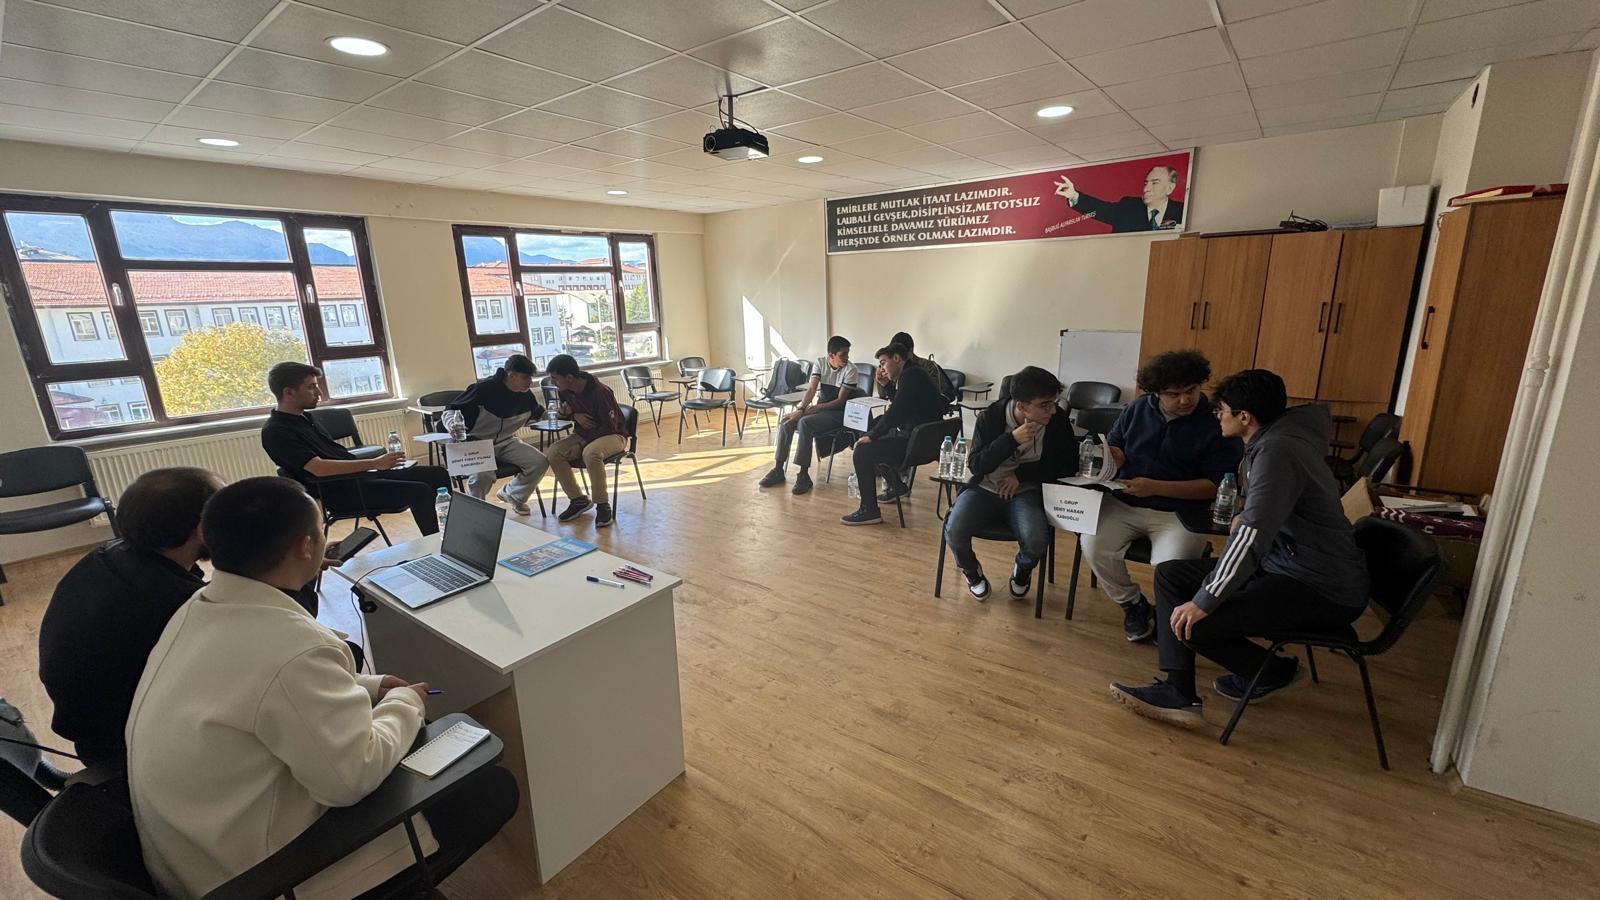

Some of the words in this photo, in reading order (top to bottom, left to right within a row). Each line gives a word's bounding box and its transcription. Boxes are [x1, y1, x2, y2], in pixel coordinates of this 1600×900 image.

[836, 202, 878, 215] EMİRLERE
[880, 197, 920, 210] MUTLAK
[923, 194, 951, 205] İTAAT
[954, 187, 1013, 201] LAZIMDIR.
[836, 212, 871, 226] LAUBALİ
[837, 224, 889, 236] KİMSELERLE
[891, 220, 935, 231] DAVAMIZ
[937, 214, 990, 228] YÜRÜMEZ
[837, 236, 880, 247] HERŞEYDE
[882, 233, 916, 243] ÖRNEK
[918, 231, 955, 240] OLMAK
[958, 225, 1016, 238] LAZIMDIR.
